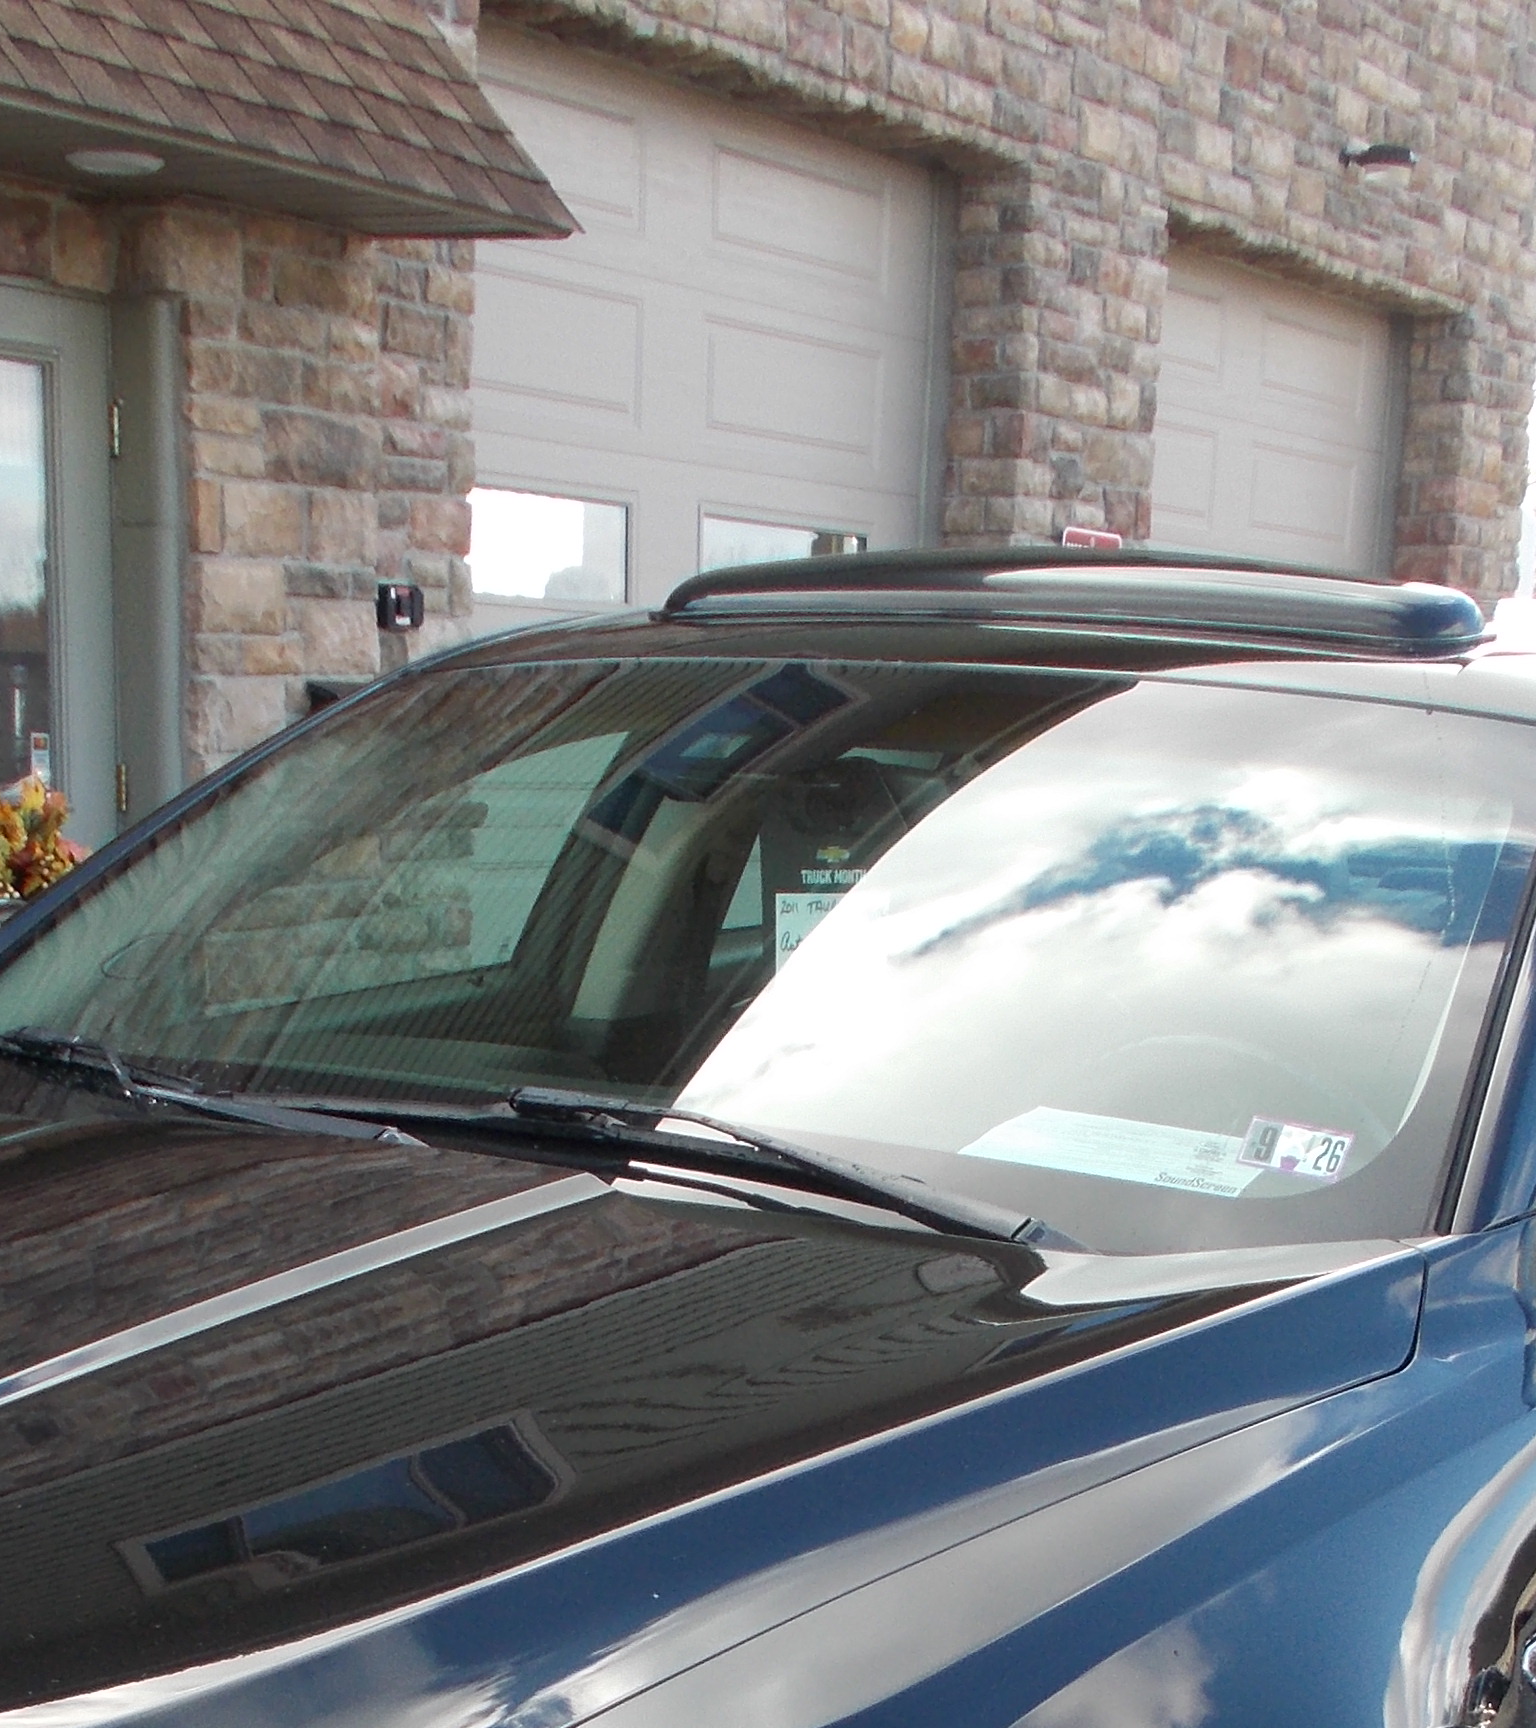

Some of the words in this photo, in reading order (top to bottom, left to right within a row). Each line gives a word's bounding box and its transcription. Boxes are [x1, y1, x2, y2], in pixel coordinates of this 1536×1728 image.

[800, 868, 833, 885] TRUCK
[1253, 1126, 1279, 1161] 9
[1312, 1136, 1346, 1174] 26
[1154, 1171, 1238, 1195] SoundScreen
